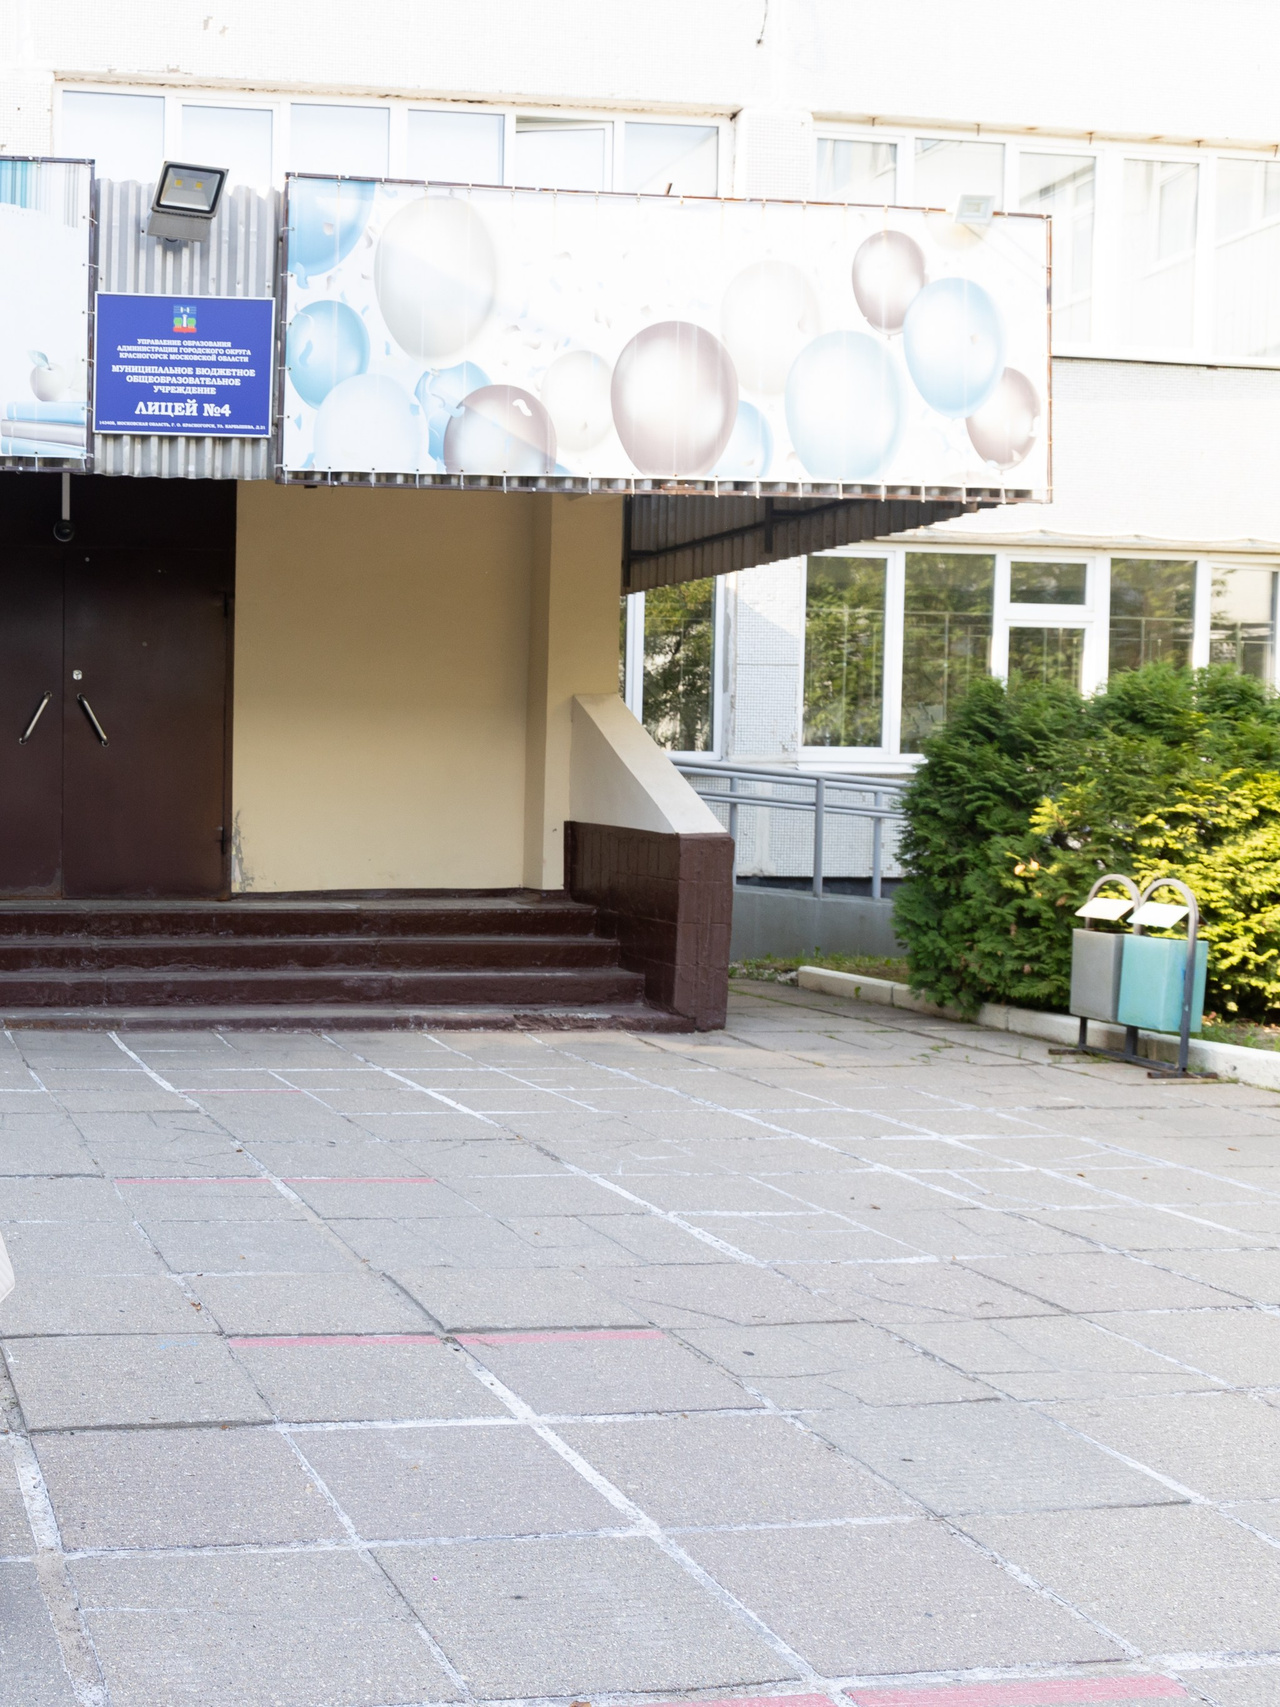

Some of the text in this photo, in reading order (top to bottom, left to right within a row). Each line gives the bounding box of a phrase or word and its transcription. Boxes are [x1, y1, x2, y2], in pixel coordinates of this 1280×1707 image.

[137, 338, 232, 348] УПРАВЛЕНИЕ ОБРАЗОВАНИЯ
[117, 345, 178, 353] АДМИНИСТРАЦИИ
[179, 347, 225, 355] ГОРОДСКОГО
[119, 352, 249, 363] КРАСНОГОРСК МОСКОВСКОЙ ОБЛАСТИ
[111, 365, 256, 377] МУНИЦИПАЛЬНОЕ БЮДЖЕТНОЕ
[126, 375, 241, 386] ОБЩЕОБРАЗОВАТЕЛЬНОЕ
[153, 385, 217, 395] УЧРЕЖДЕНИЕ
[135, 399, 232, 417] ЛИЦЕЙ №4
